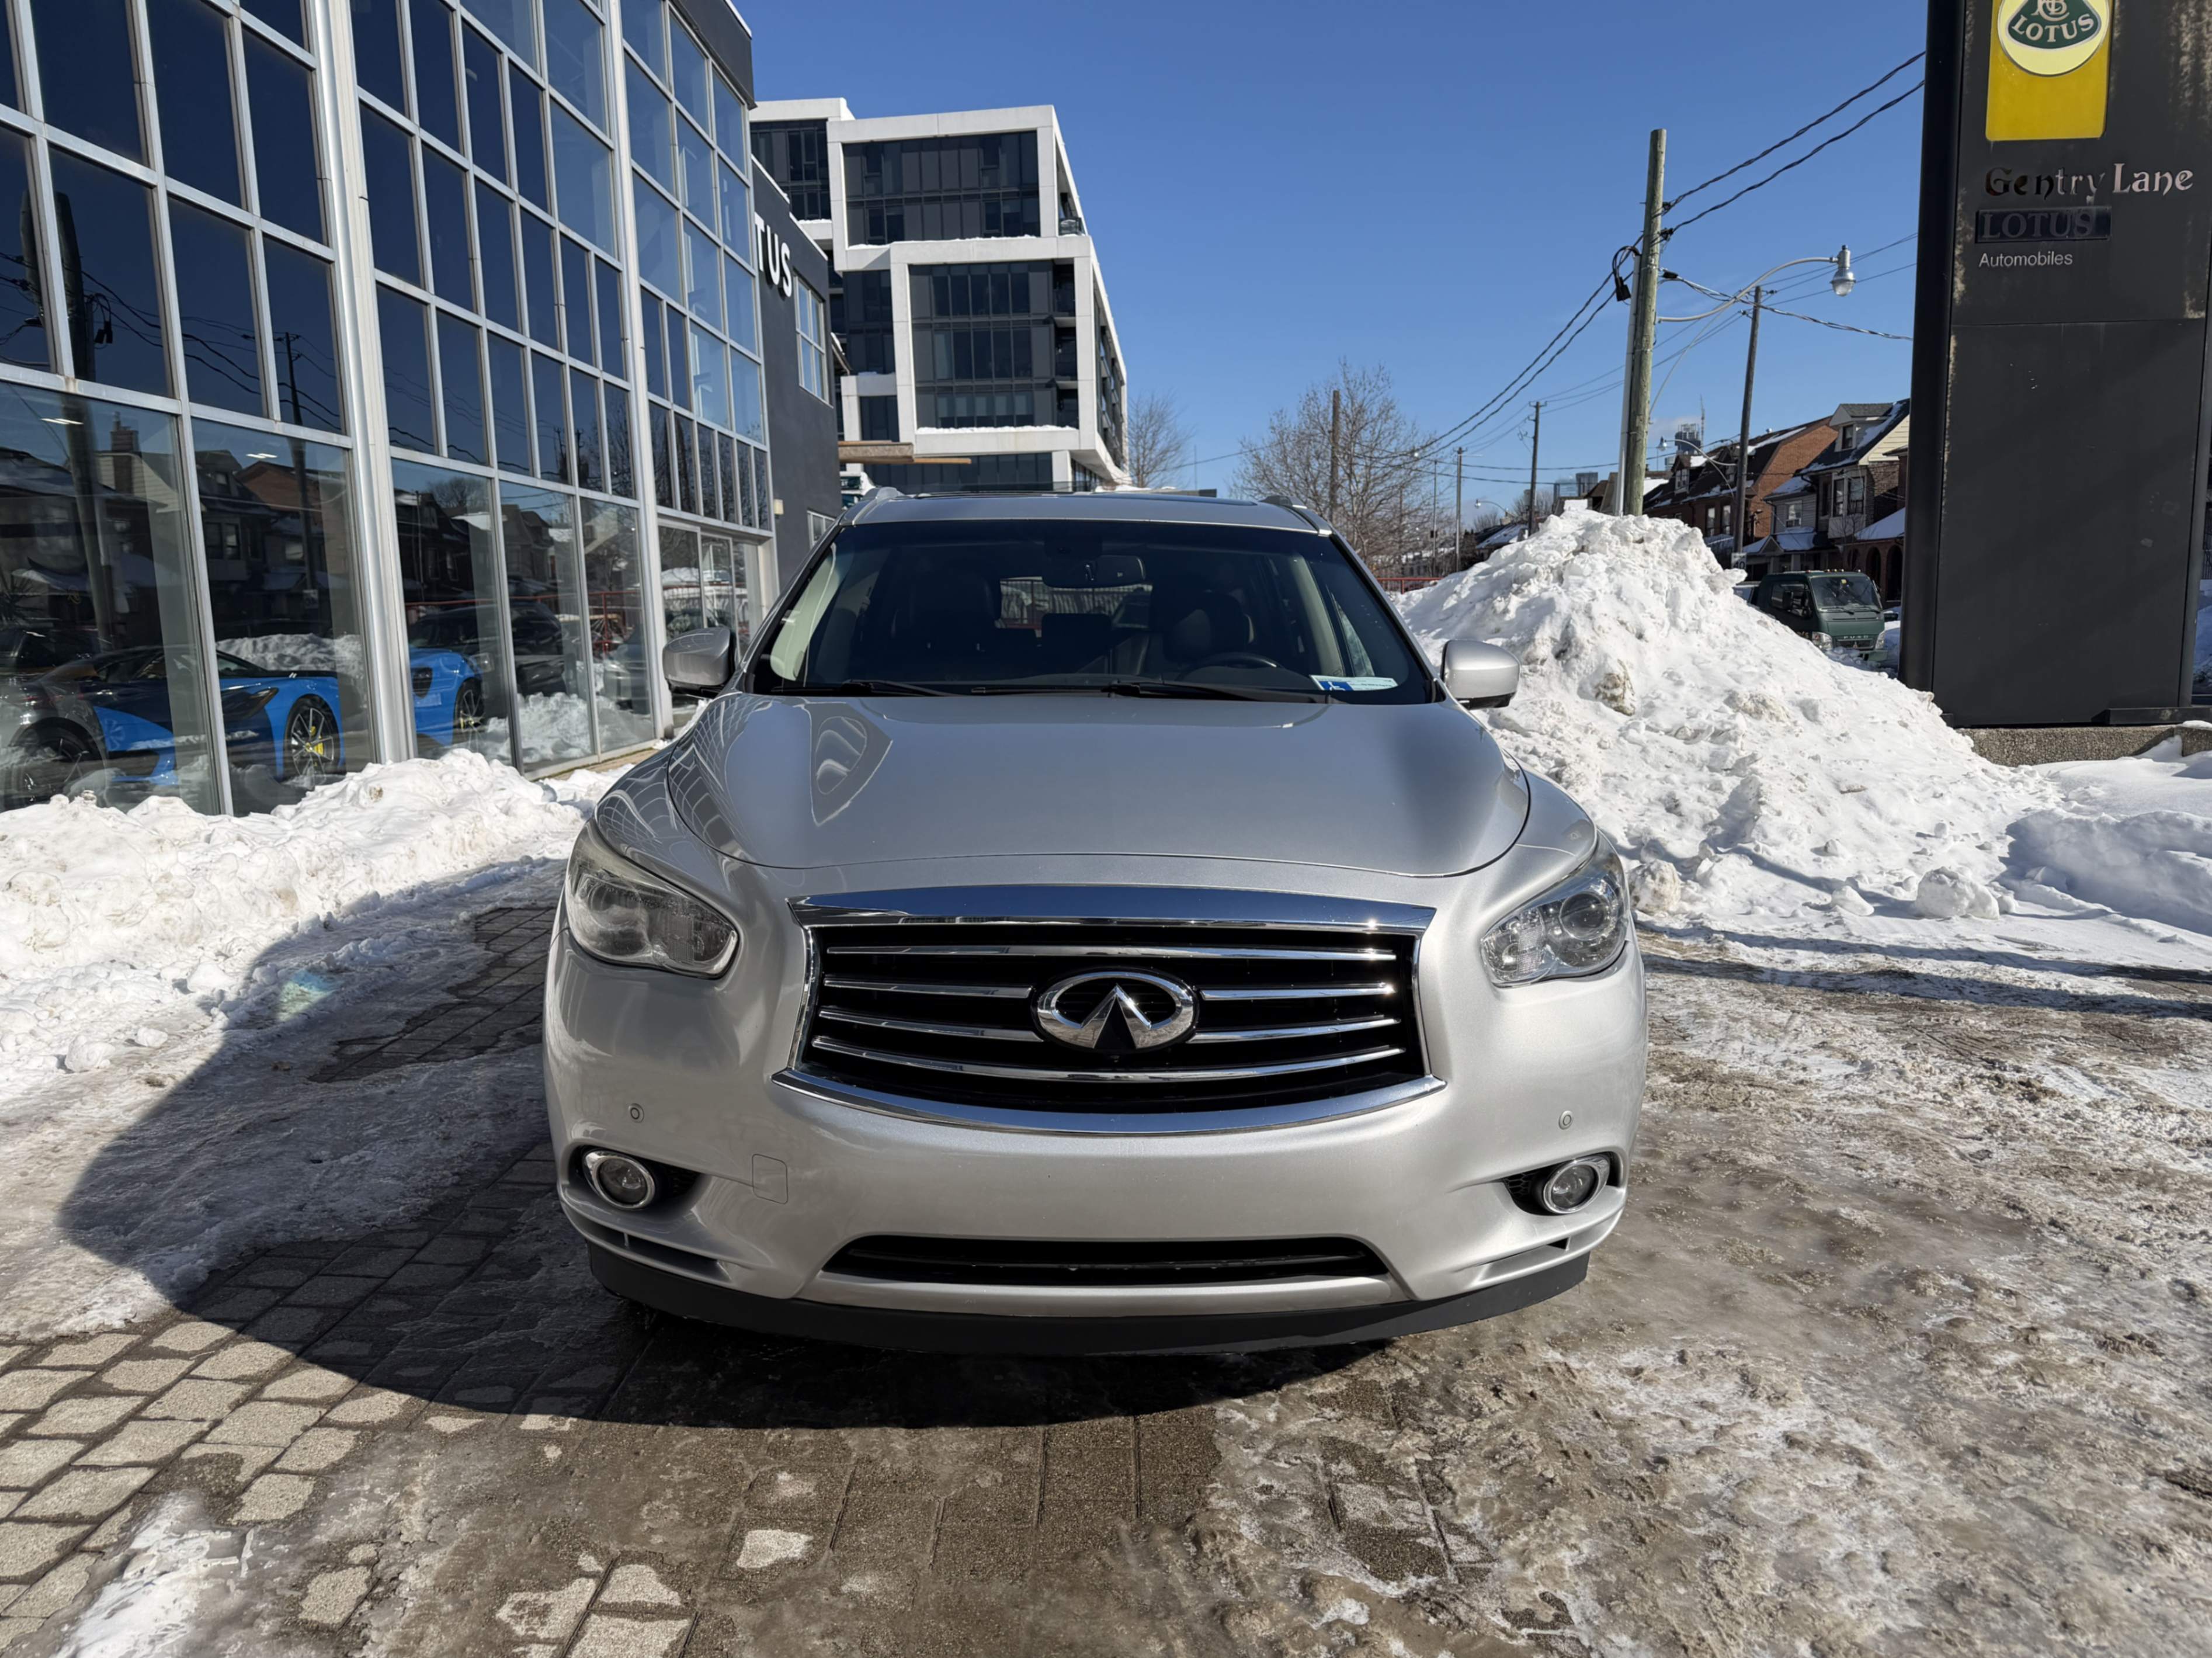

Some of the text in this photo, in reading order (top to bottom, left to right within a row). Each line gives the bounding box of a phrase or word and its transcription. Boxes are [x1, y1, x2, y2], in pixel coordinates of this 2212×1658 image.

[2011, 13, 2095, 43] LOTUS
[1985, 163, 2194, 205] Gentry Lane
[1981, 212, 2093, 238] LOTUS
[1978, 251, 2073, 267] Automobiles
